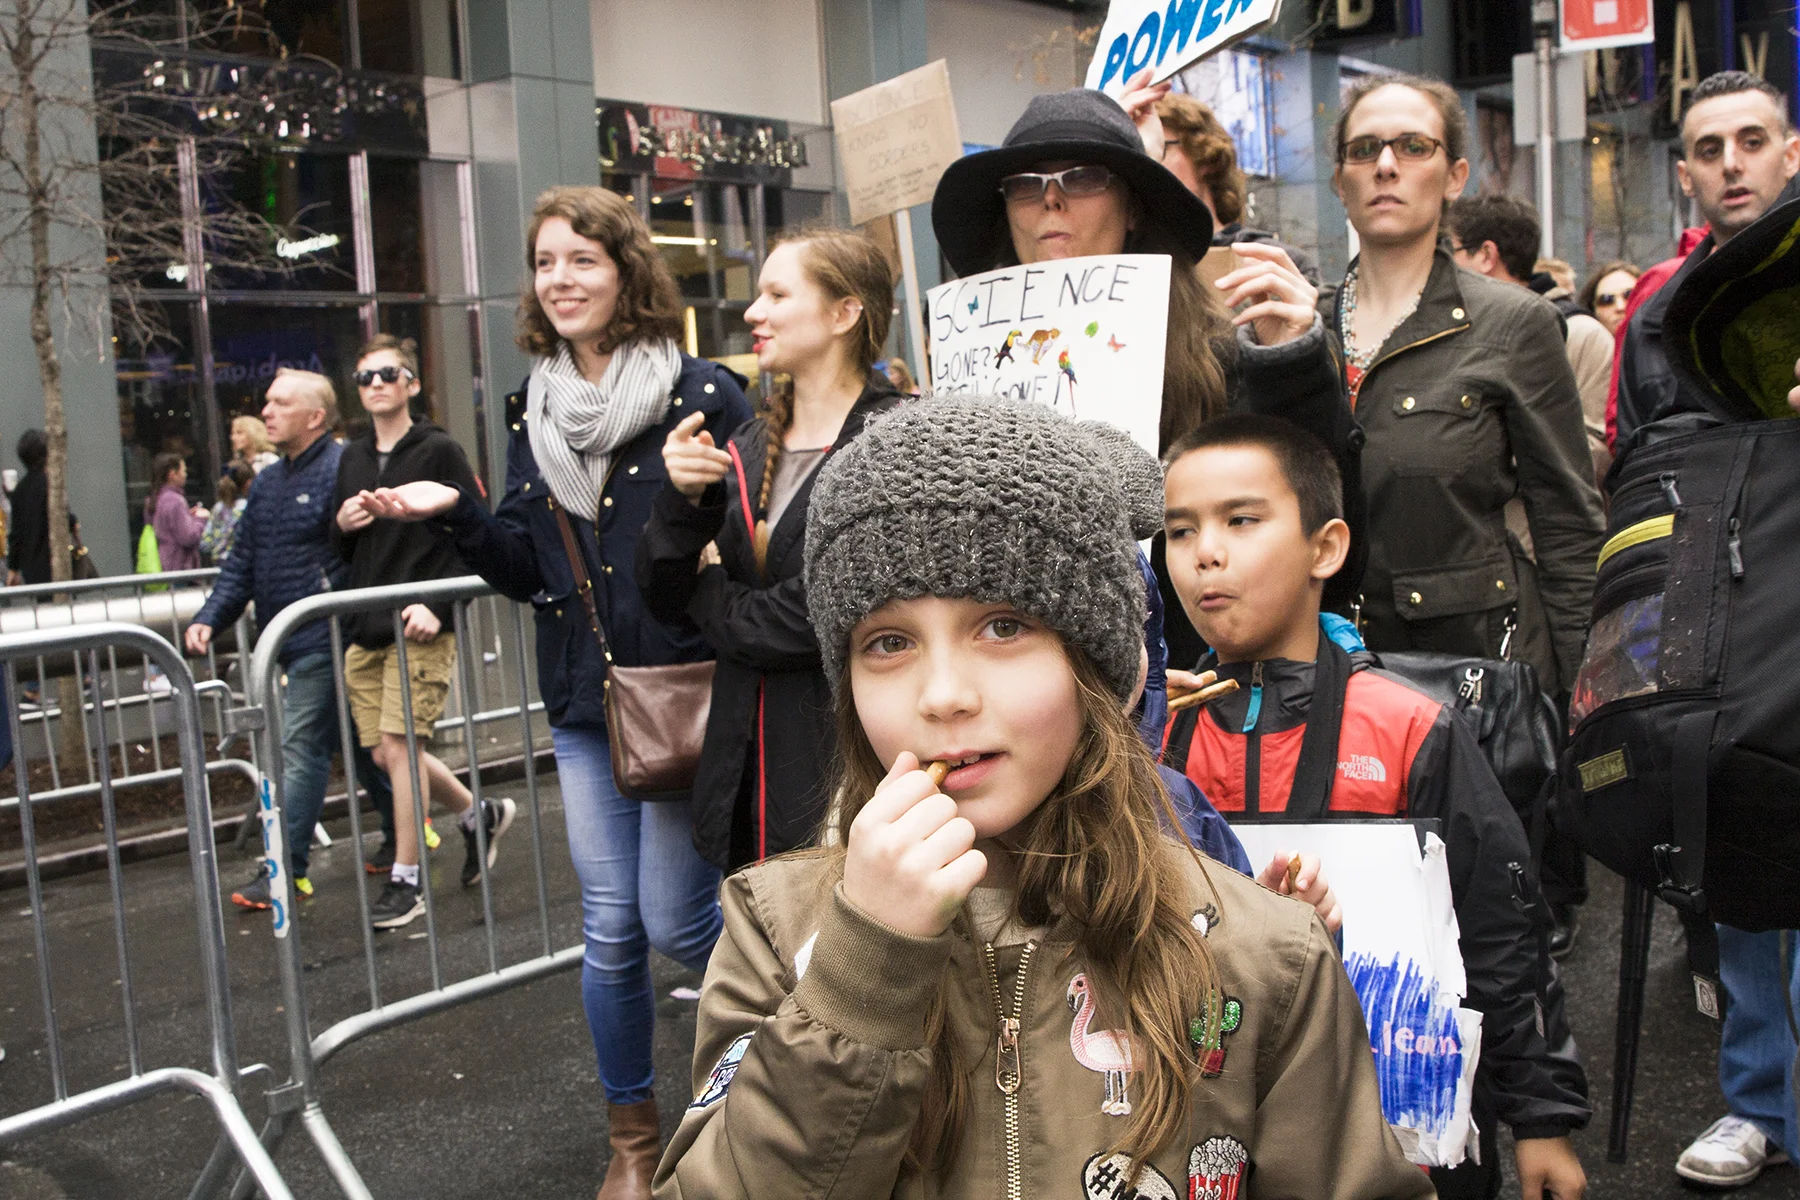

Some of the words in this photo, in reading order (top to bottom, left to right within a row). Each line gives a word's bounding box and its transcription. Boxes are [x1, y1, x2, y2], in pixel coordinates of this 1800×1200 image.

[935, 264, 1139, 342] SCIENCE
[935, 346, 992, 381] GONE?
[1336, 761, 1369, 772] NORTH
[1350, 754, 1369, 763] THE
[1344, 769, 1368, 780] FACE
[1371, 1020, 1458, 1057] lean
